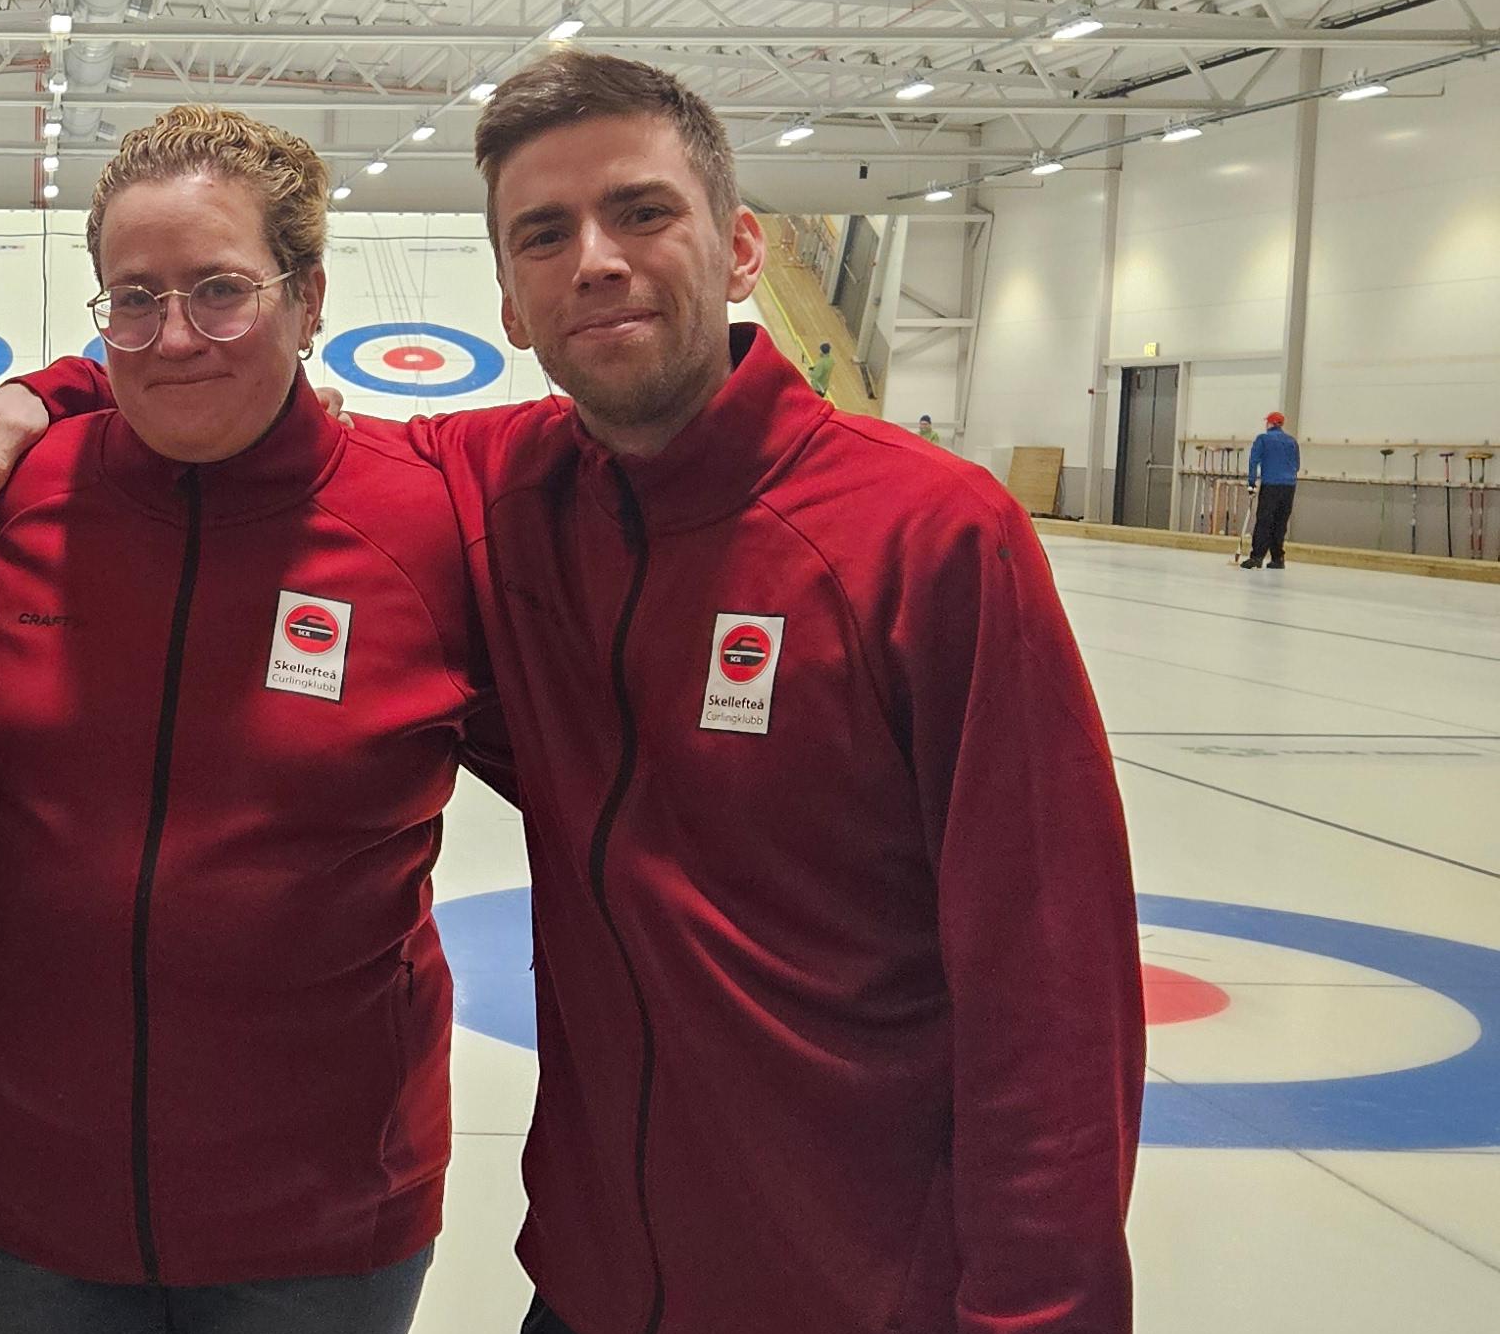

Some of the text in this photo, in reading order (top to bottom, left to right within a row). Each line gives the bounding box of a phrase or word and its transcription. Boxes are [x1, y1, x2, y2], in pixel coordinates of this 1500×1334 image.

[273, 659, 337, 680] Skellefteå
[272, 673, 336, 692] Curlingklubb
[708, 694, 764, 711] Skellefteå
[705, 710, 764, 726] Curlingklubb
